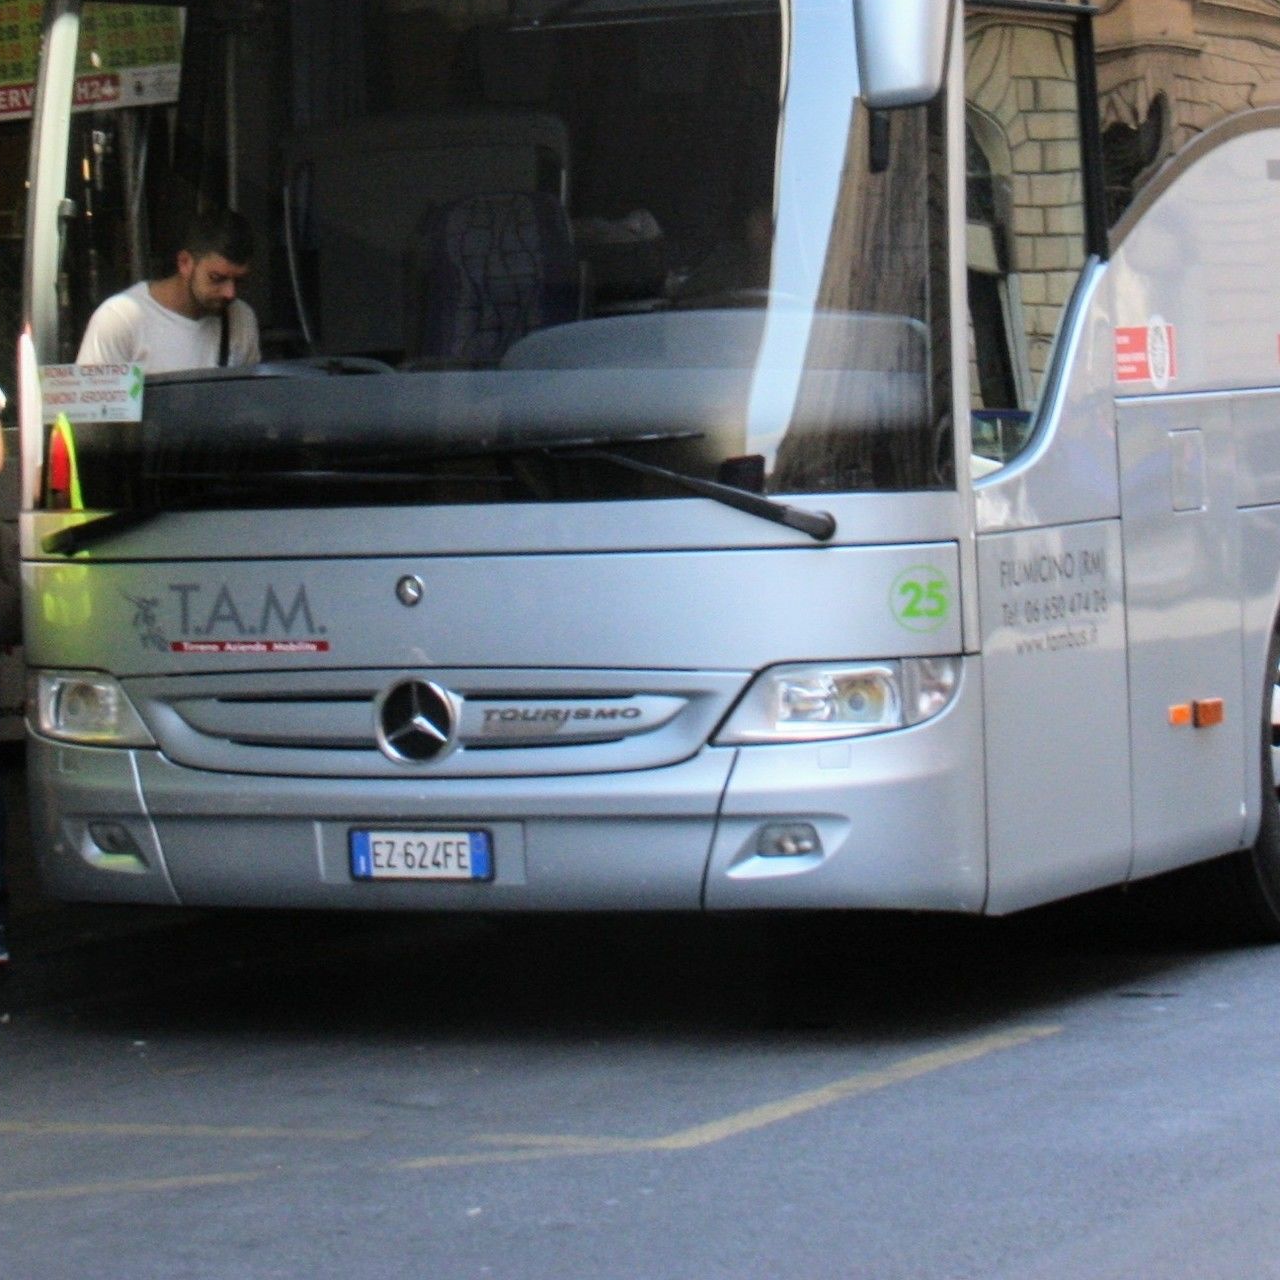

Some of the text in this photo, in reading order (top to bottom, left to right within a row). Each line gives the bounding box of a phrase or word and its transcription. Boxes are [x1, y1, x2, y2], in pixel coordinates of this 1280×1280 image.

[170, 583, 328, 634] T.A.M.
[898, 579, 949, 618] 25
[483, 706, 643, 721] TOURISMO
[372, 840, 396, 869] EZ
[403, 840, 470, 870] 624FE
